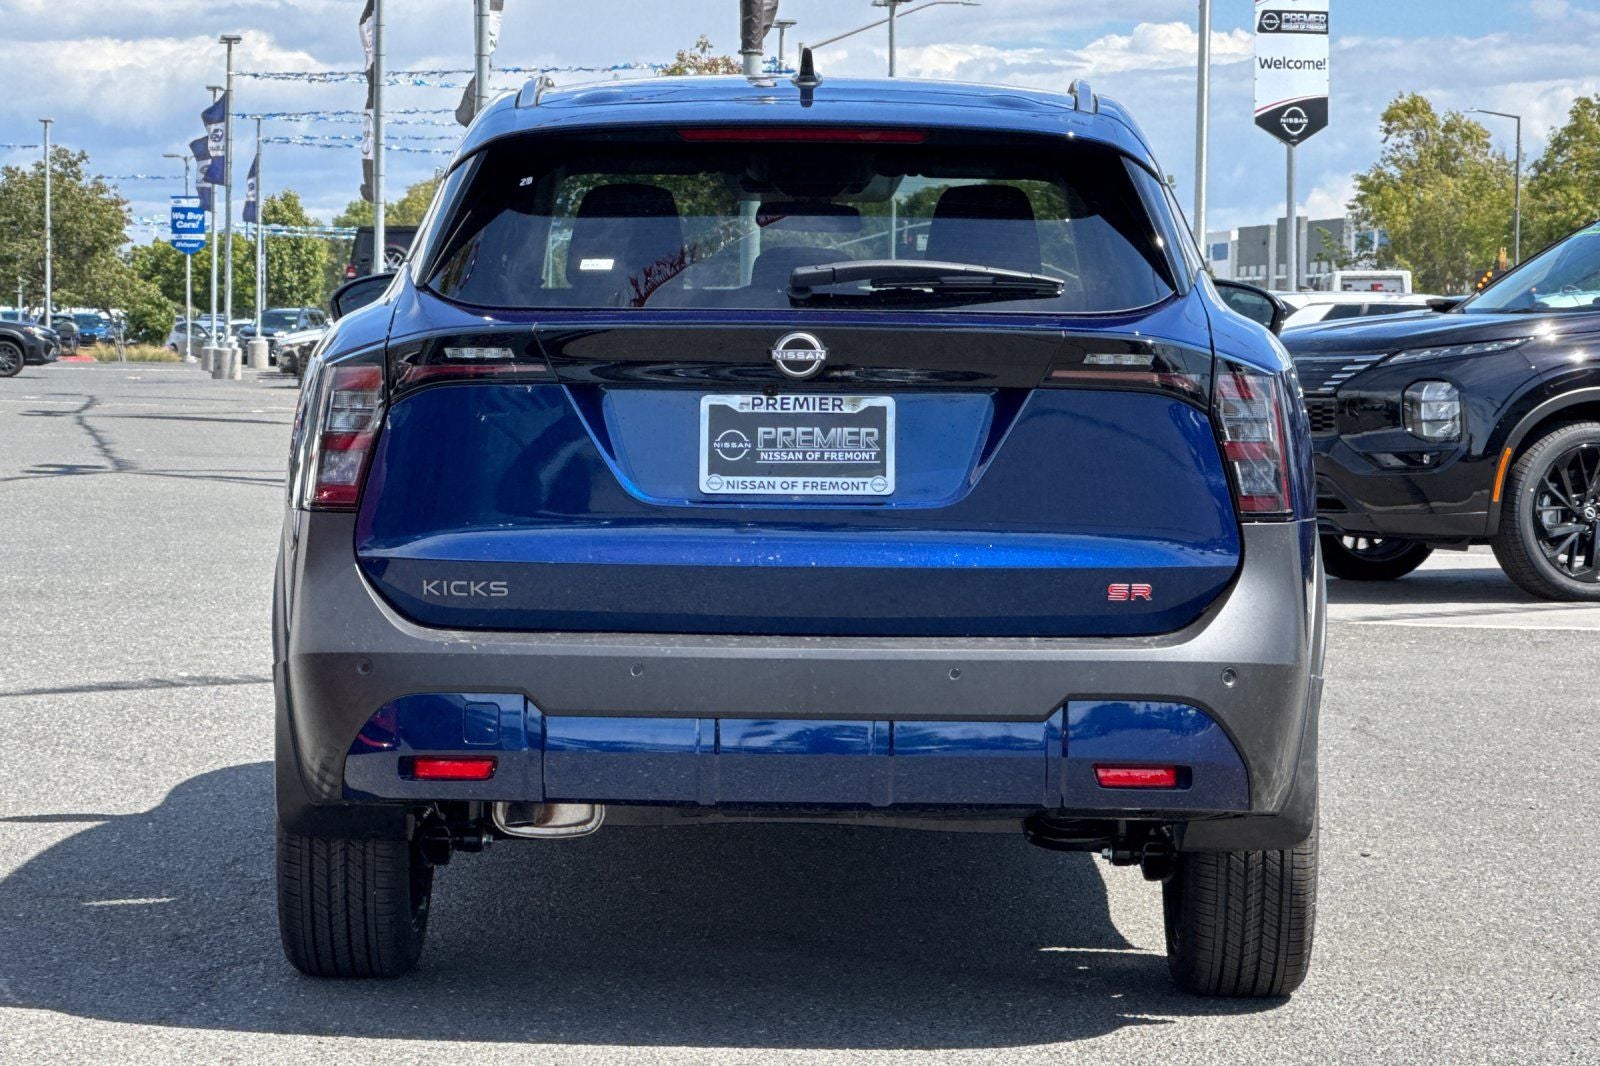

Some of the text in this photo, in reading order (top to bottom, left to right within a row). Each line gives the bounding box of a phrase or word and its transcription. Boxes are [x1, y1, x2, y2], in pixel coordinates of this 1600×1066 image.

[1281, 13, 1327, 24] PREMIER
[1258, 56, 1327, 71] Welcome!
[172, 211, 204, 221] We Buy
[772, 350, 826, 360] NISSAN
[751, 396, 844, 412] PREMIER
[757, 427, 880, 450] PREMIER
[760, 451, 877, 461] NISSAN OF FREMONT
[725, 480, 776, 491] NISSAN
[780, 480, 799, 491] OF
[802, 481, 869, 492] FREMONT
[422, 579, 509, 597] KICKS
[1107, 583, 1153, 601] SR
